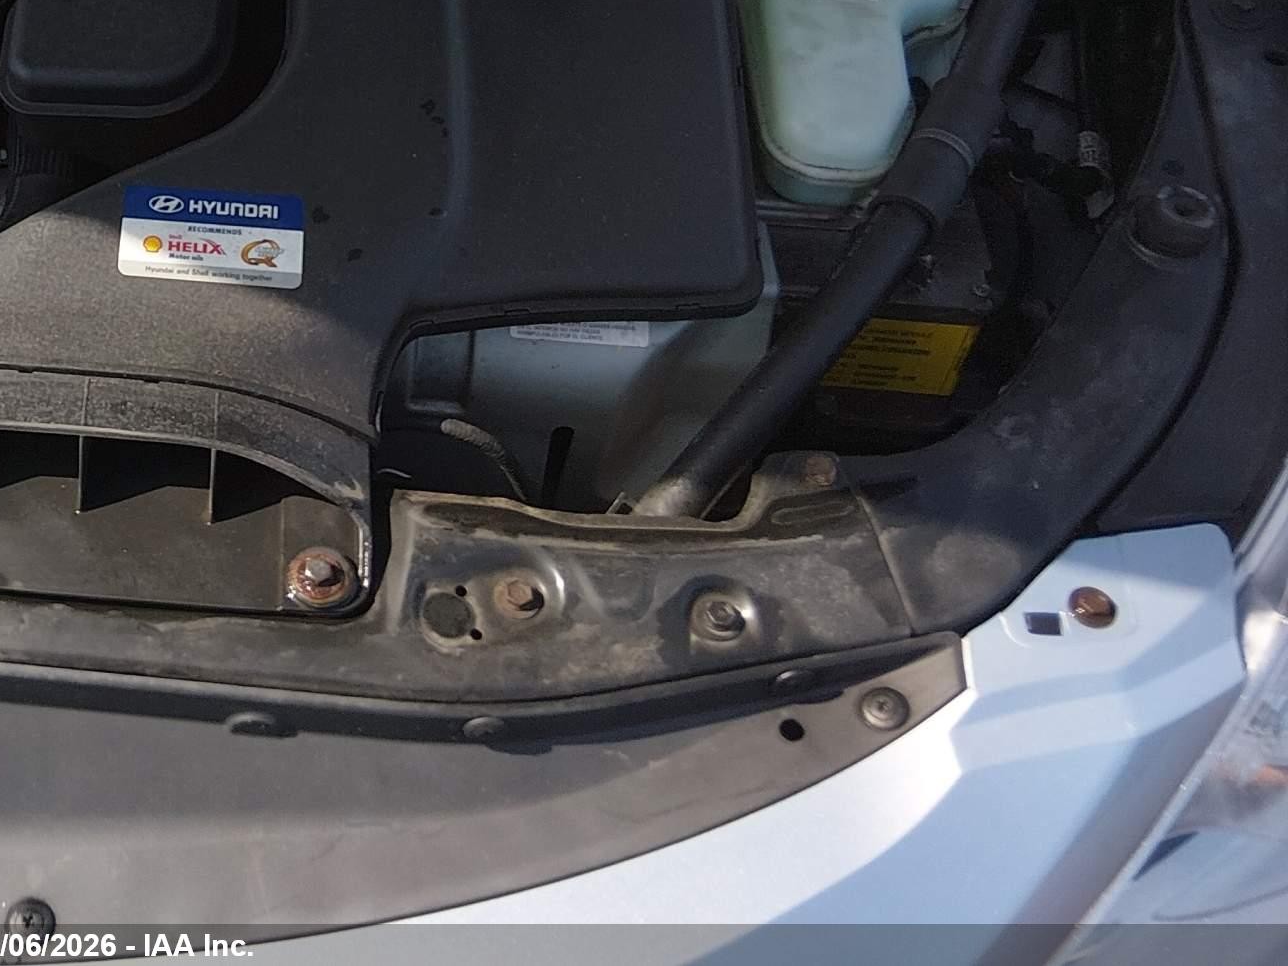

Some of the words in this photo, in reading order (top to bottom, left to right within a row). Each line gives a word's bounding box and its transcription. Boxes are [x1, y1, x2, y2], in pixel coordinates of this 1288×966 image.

[189, 199, 278, 219] HYUNDAI
[187, 225, 242, 236] RECOMMENDS
[168, 239, 224, 256] HELIX
[145, 265, 174, 276] Hyundai
[177, 268, 190, 276] and
[192, 267, 209, 277] Shell
[212, 269, 240, 281] working
[242, 272, 273, 283] together
